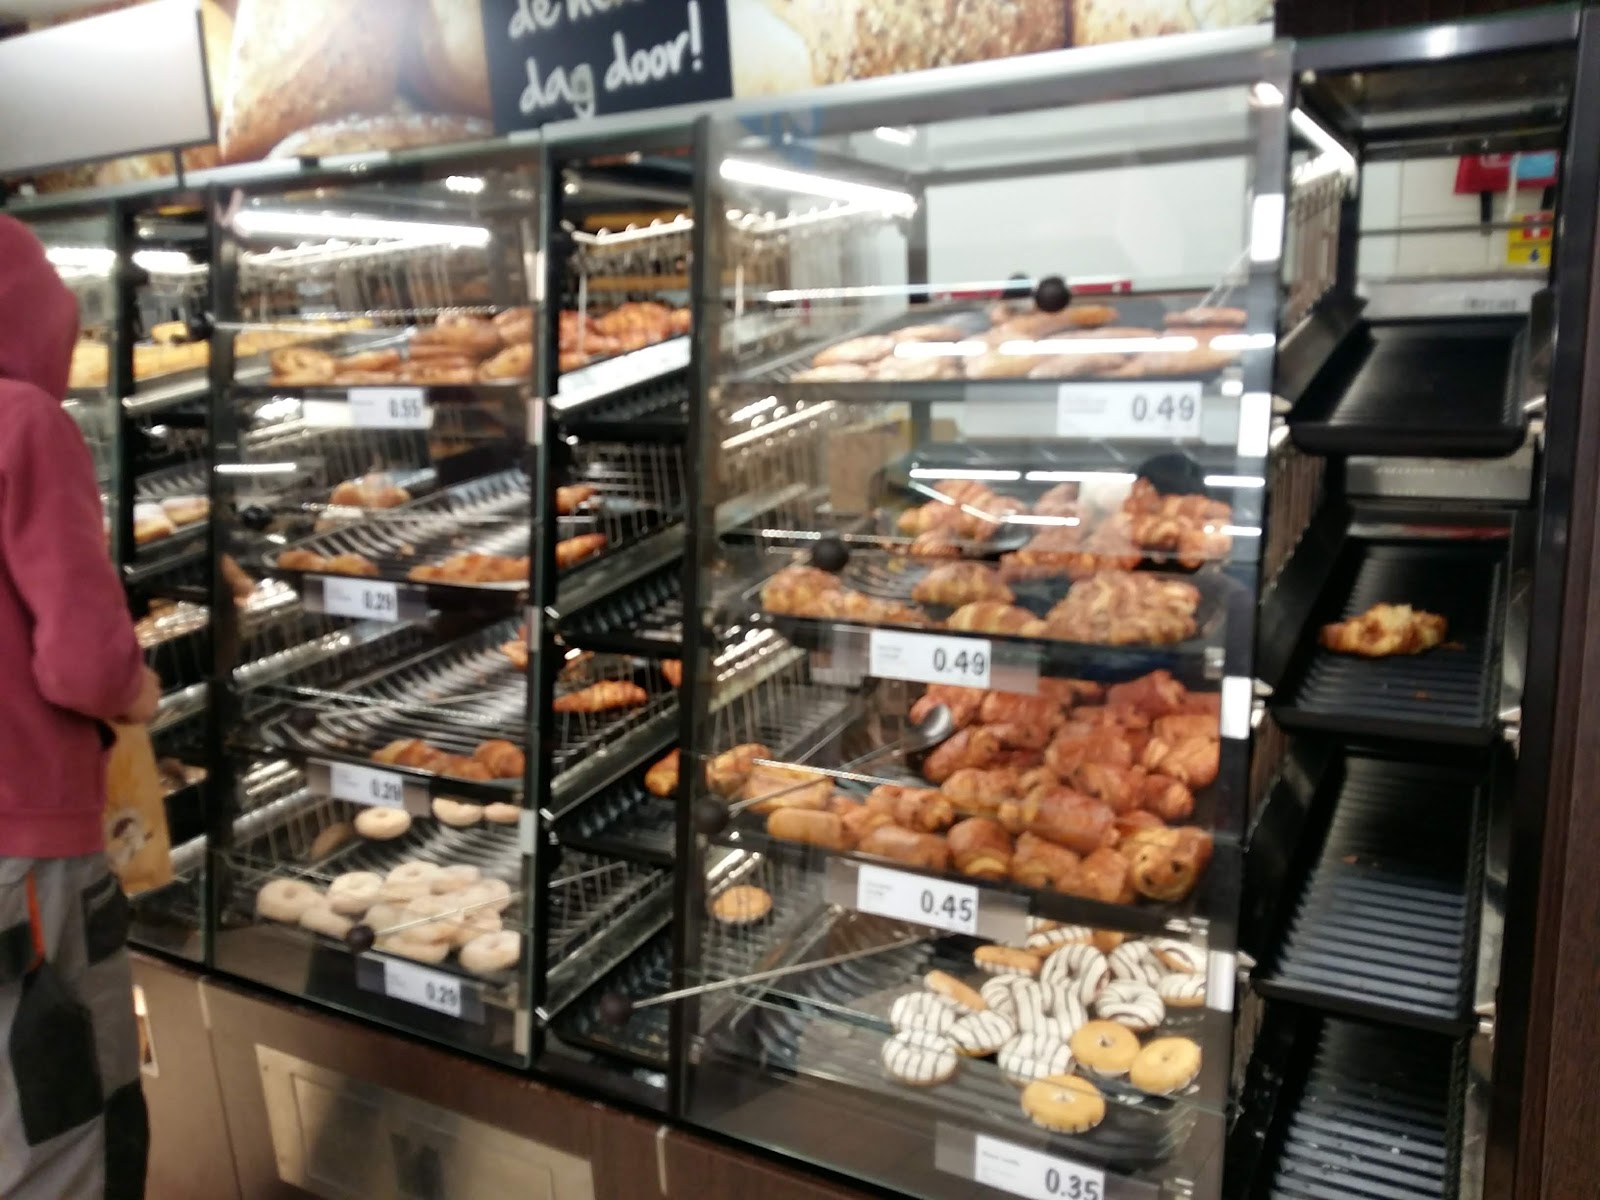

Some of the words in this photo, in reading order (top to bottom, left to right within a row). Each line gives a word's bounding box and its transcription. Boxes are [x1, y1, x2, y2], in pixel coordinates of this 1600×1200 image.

[518, 56, 597, 119] dag
[603, 0, 703, 91] door!
[1131, 394, 1196, 422] 0.49
[933, 647, 986, 676] 0.49
[920, 889, 973, 922] 0.45
[1045, 1168, 1100, 1200] 0.35
